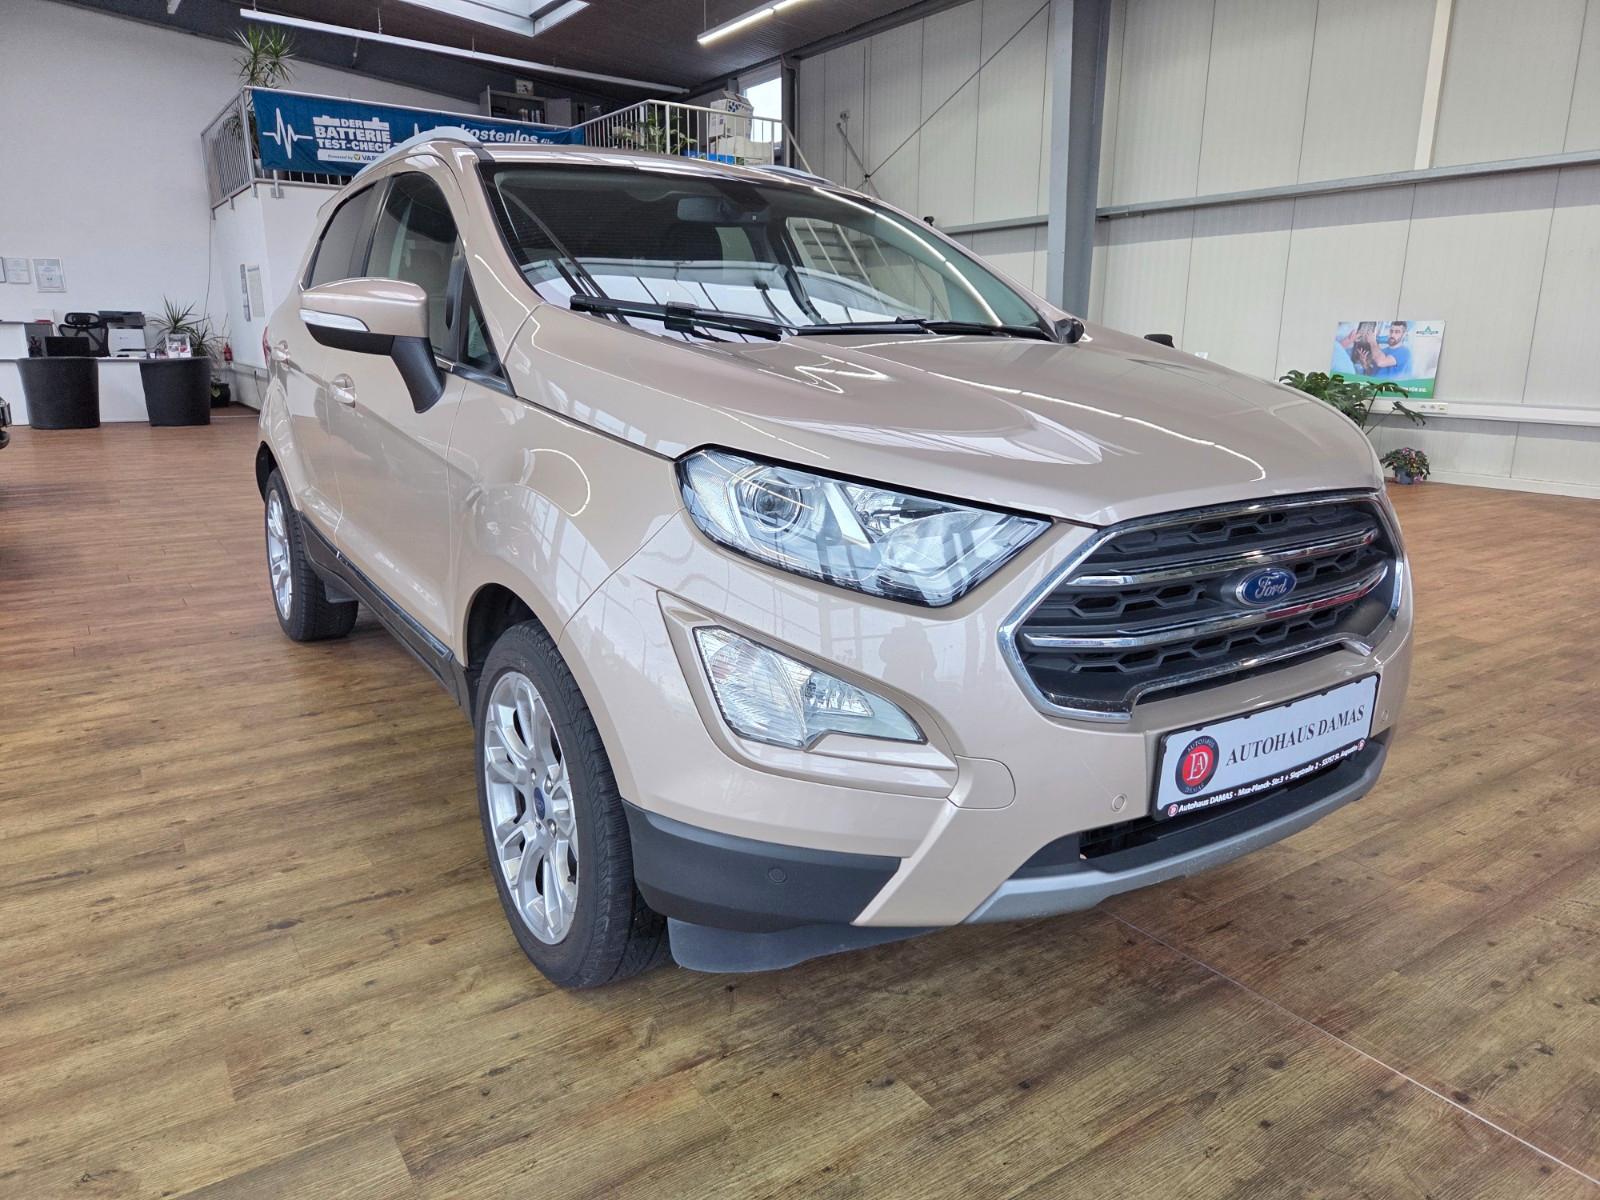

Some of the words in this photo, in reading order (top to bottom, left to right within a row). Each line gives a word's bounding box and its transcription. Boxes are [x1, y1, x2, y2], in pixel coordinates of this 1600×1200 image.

[341, 119, 363, 128] DER
[314, 126, 391, 143] BATTERIE
[316, 138, 391, 152] TEST-CHECK
[1255, 574, 1288, 599] Ford
[1226, 723, 1316, 767] AUTOHAUS
[1317, 704, 1365, 737] DAMAS
[1178, 798, 1209, 813] Autohaus
[1209, 791, 1234, 804] DAMAS
